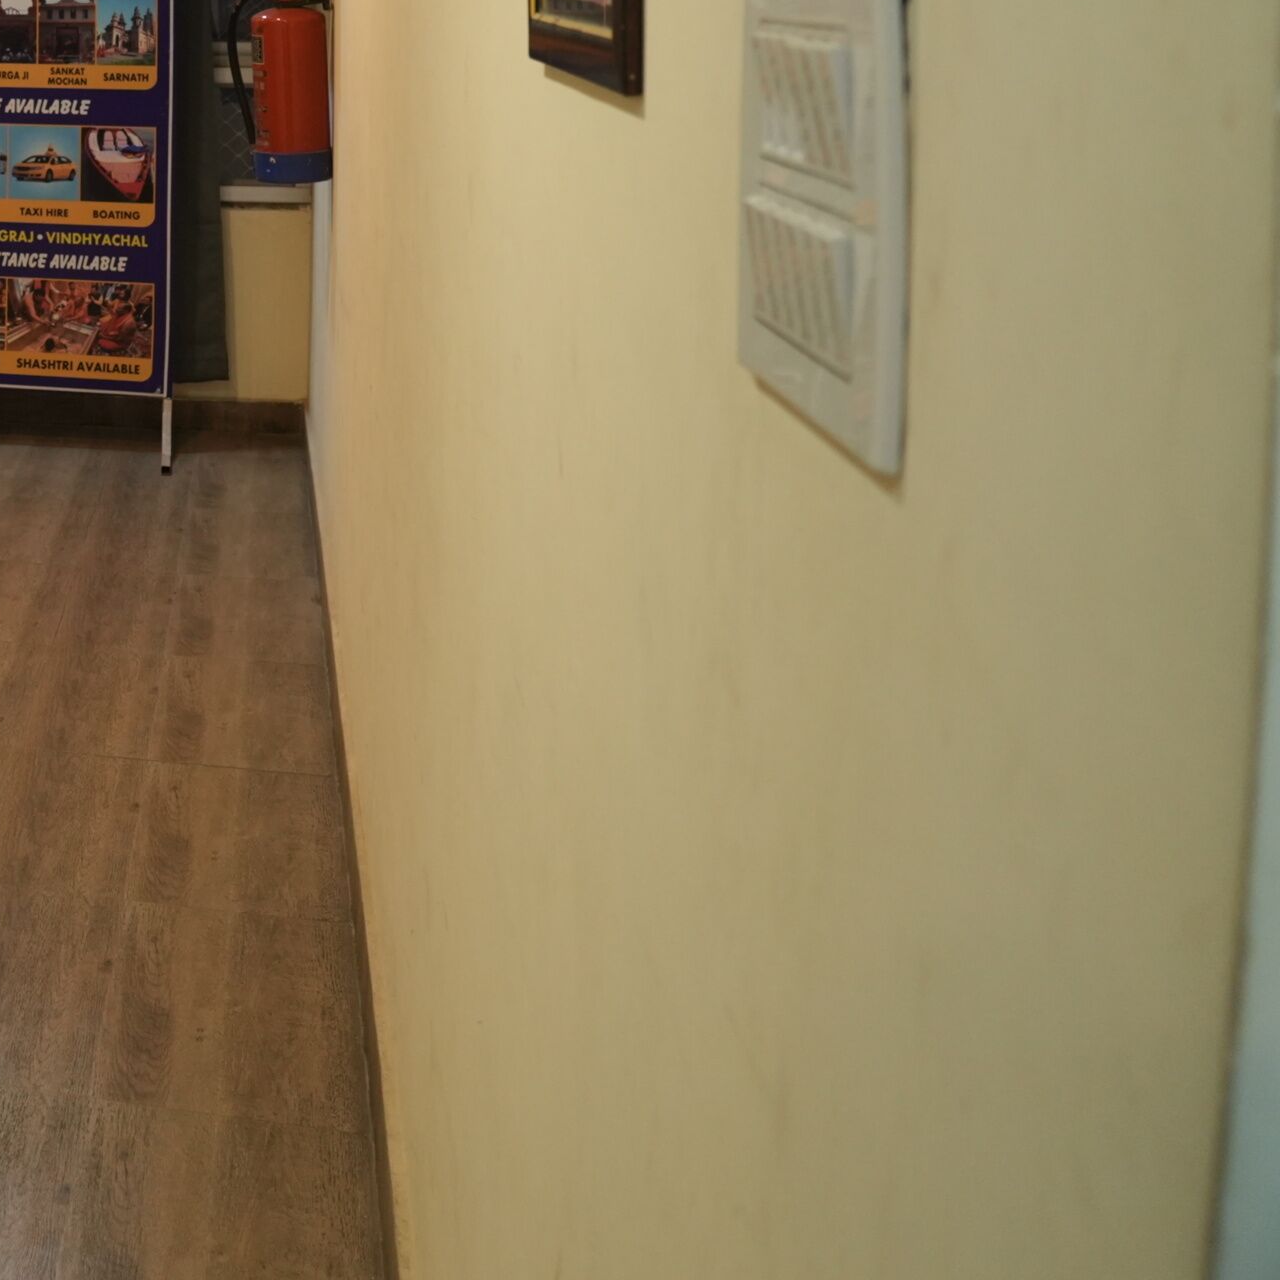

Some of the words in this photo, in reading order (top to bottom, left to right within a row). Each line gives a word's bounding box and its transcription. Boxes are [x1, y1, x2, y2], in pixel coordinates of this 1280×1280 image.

[21, 70, 30, 81] JI
[50, 67, 85, 77] SANKAT
[103, 72, 149, 83] SARNATH
[47, 77, 88, 86] MOCHAN
[5, 97, 91, 116] AVAILABLE
[19, 207, 43, 217] TAXI
[46, 207, 69, 218] HIRE
[93, 209, 141, 221] BOATING
[46, 231, 148, 248] VINDHYACHAL
[50, 254, 128, 272] AVAILABLE
[16, 358, 74, 371] SHASHTRI
[77, 361, 140, 376] AVAILABLE
